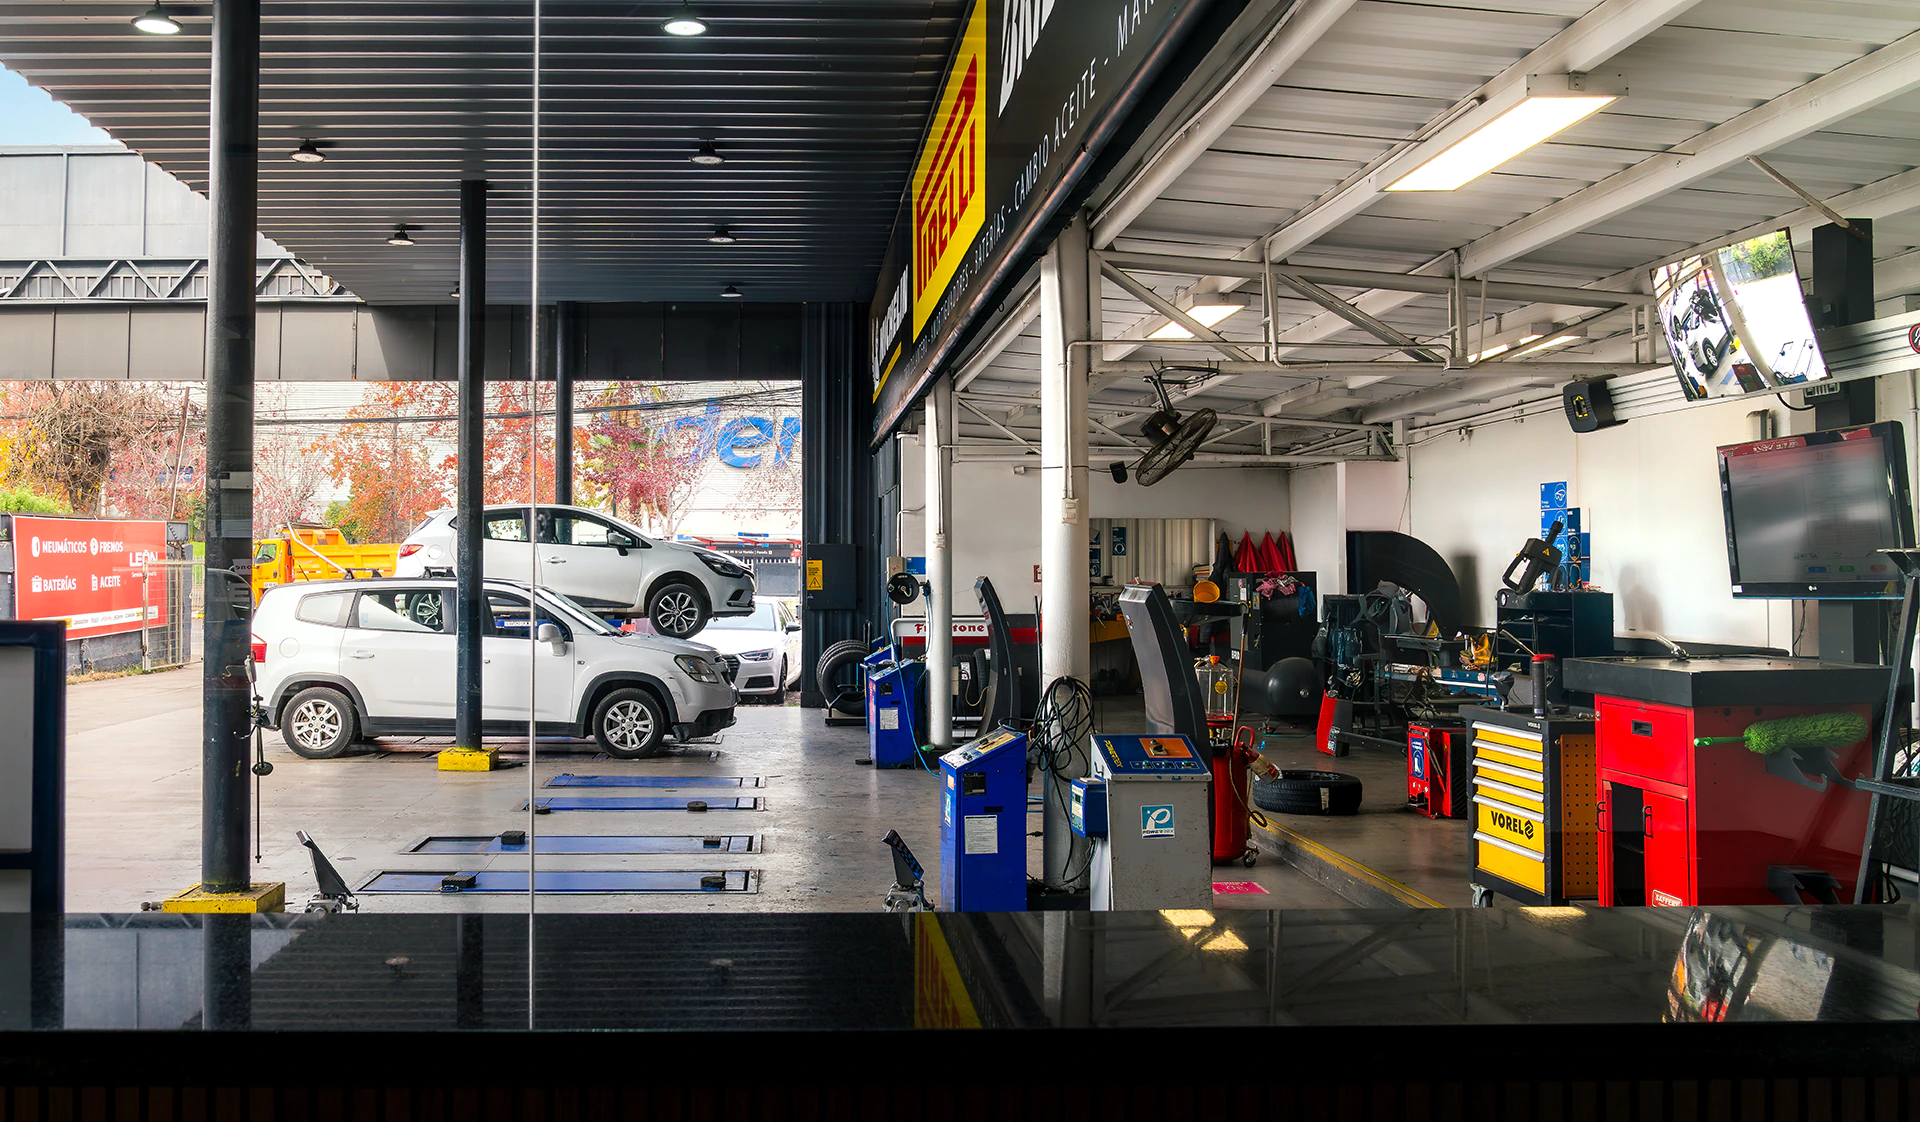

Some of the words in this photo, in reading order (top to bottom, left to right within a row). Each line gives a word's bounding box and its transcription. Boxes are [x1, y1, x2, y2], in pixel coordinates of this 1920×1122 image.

[916, 53, 978, 303] PIRELLI
[974, 205, 1006, 275] BATERÍAS
[1014, 134, 1049, 211] CAMBIO
[1054, 57, 1097, 152] ACEITE
[42, 538, 88, 554] NEUMÁTICOS
[99, 541, 124, 553] FRENOS
[43, 575, 77, 592] BATERÍAS
[99, 575, 121, 589] ACEITE
[1491, 810, 1524, 835] VOREL
